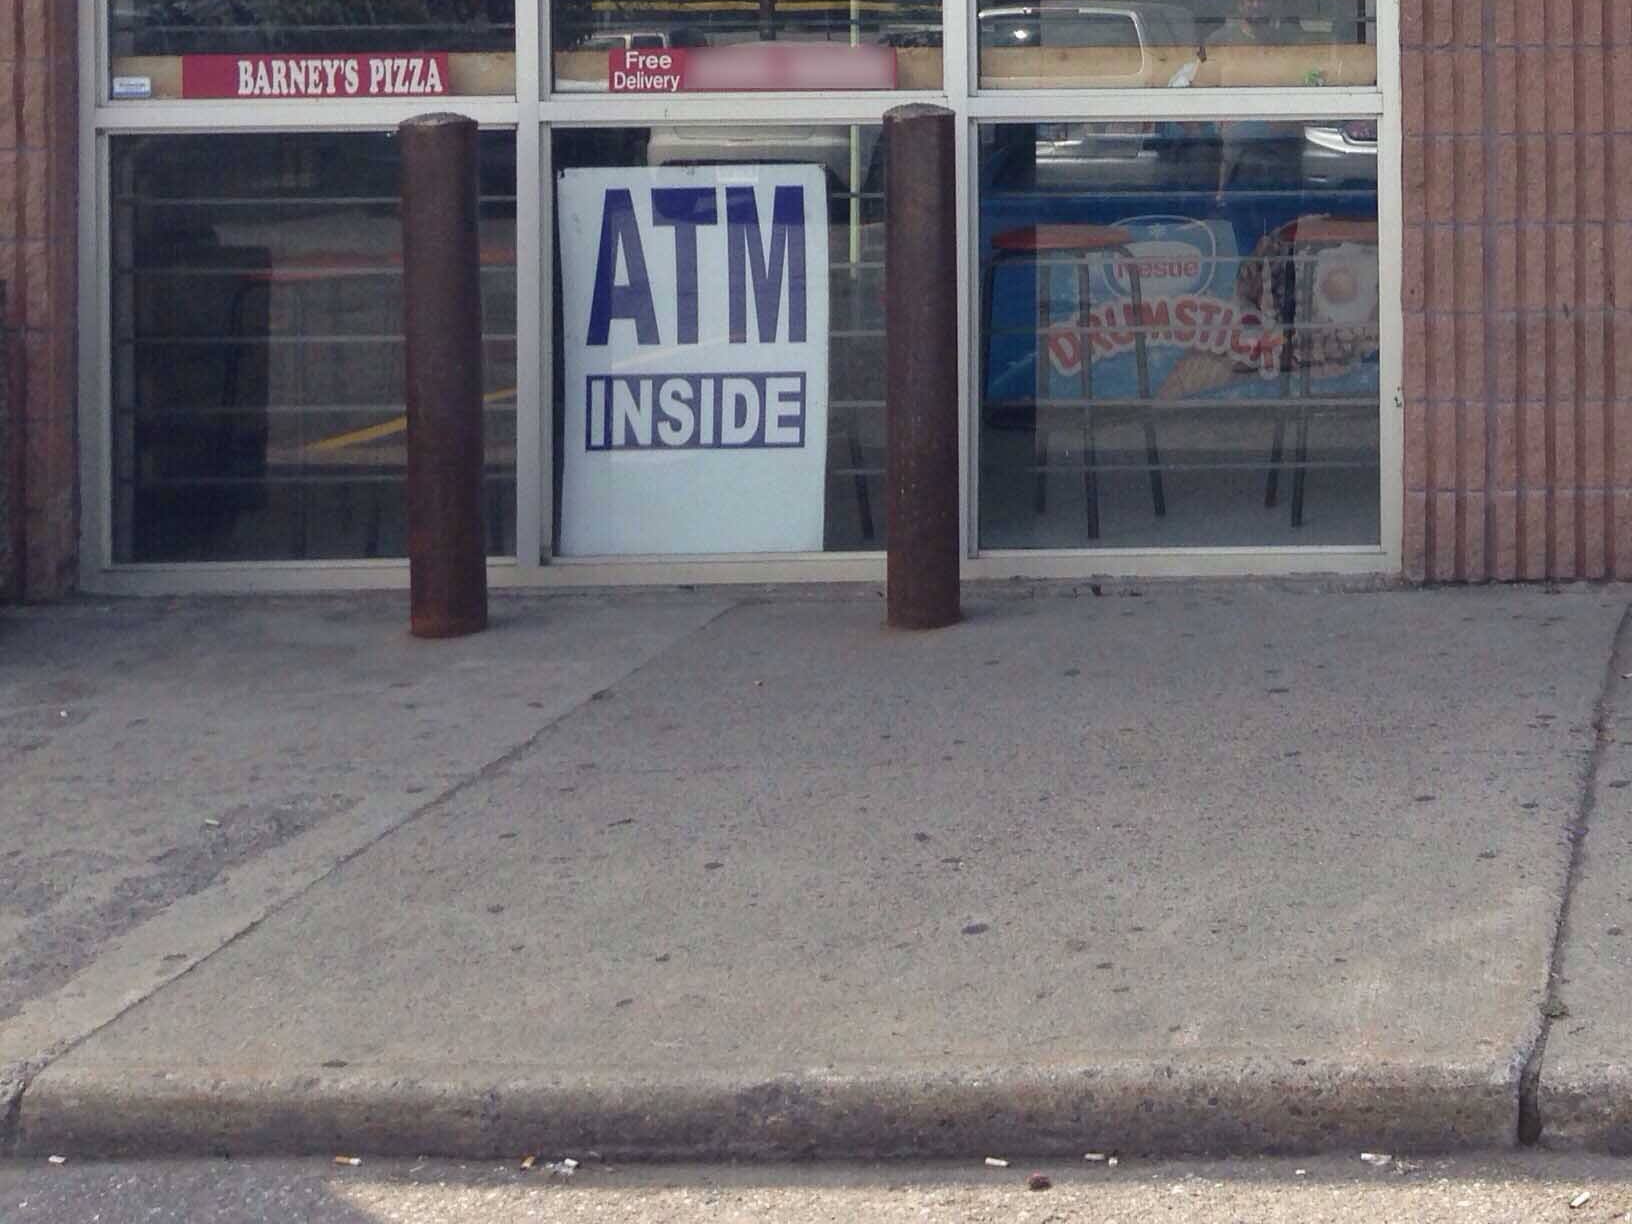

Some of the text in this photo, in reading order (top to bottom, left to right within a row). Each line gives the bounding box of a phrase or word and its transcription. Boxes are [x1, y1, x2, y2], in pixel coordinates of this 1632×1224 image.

[237, 58, 443, 95] BARNEY'S PIZZA
[625, 51, 673, 69] Free
[613, 71, 680, 92] Delivery
[586, 185, 807, 346] ATM
[590, 378, 801, 446] INSIDE
